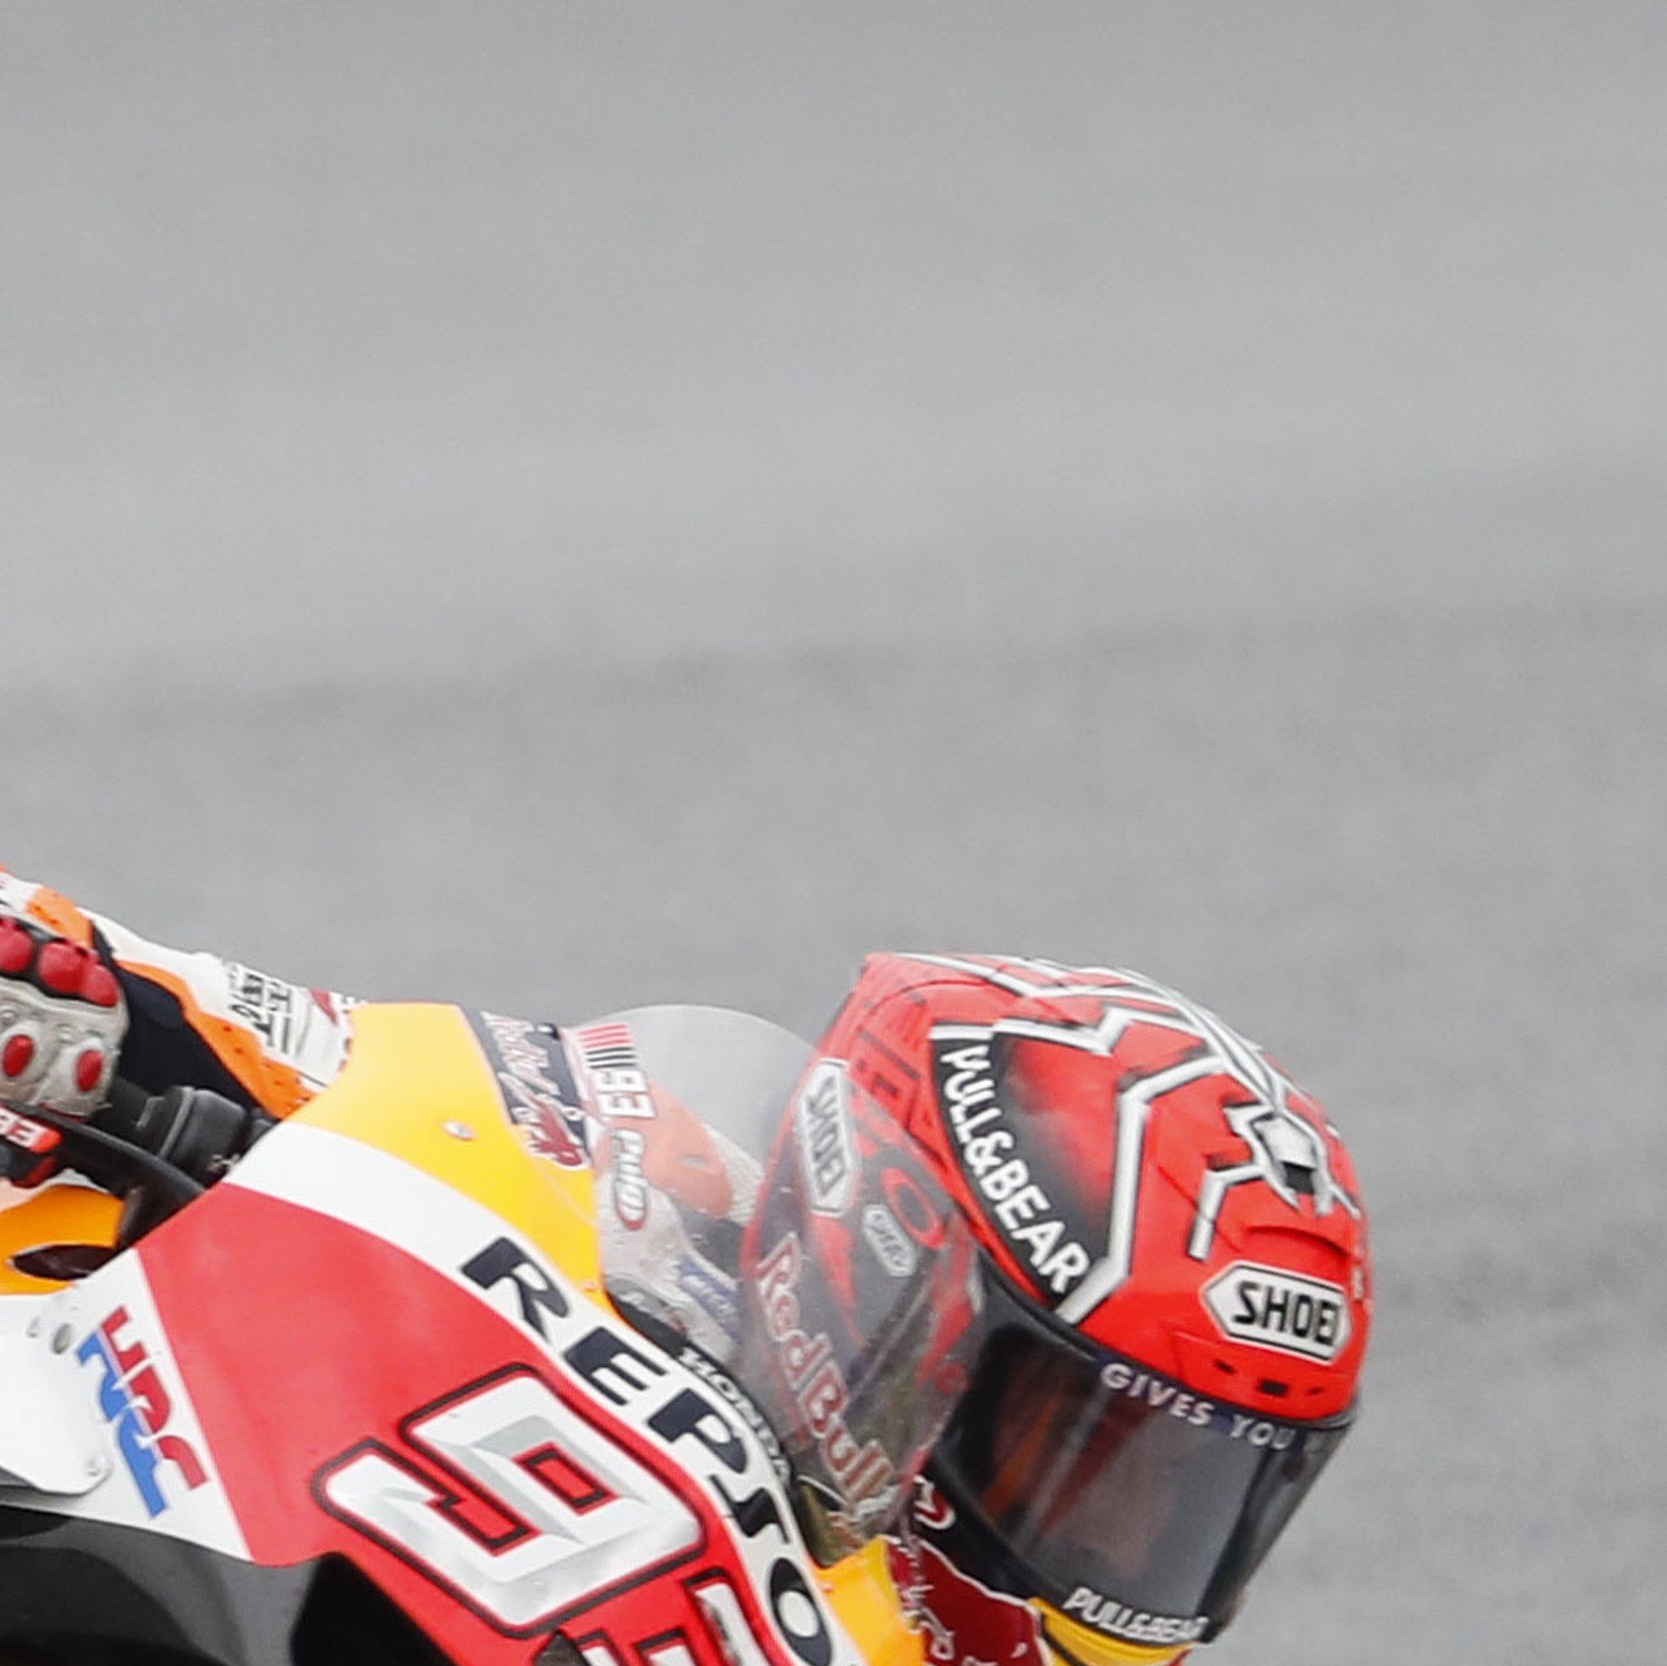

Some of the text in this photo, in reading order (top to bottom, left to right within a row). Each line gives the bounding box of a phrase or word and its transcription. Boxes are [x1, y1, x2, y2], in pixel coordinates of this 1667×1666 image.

[941, 1044, 1092, 1294] PULL&BEAR
[1231, 1278, 1341, 1350] SHOEI
[73, 1305, 213, 1520] HRC
[1100, 1362, 1213, 1428] GIVES
